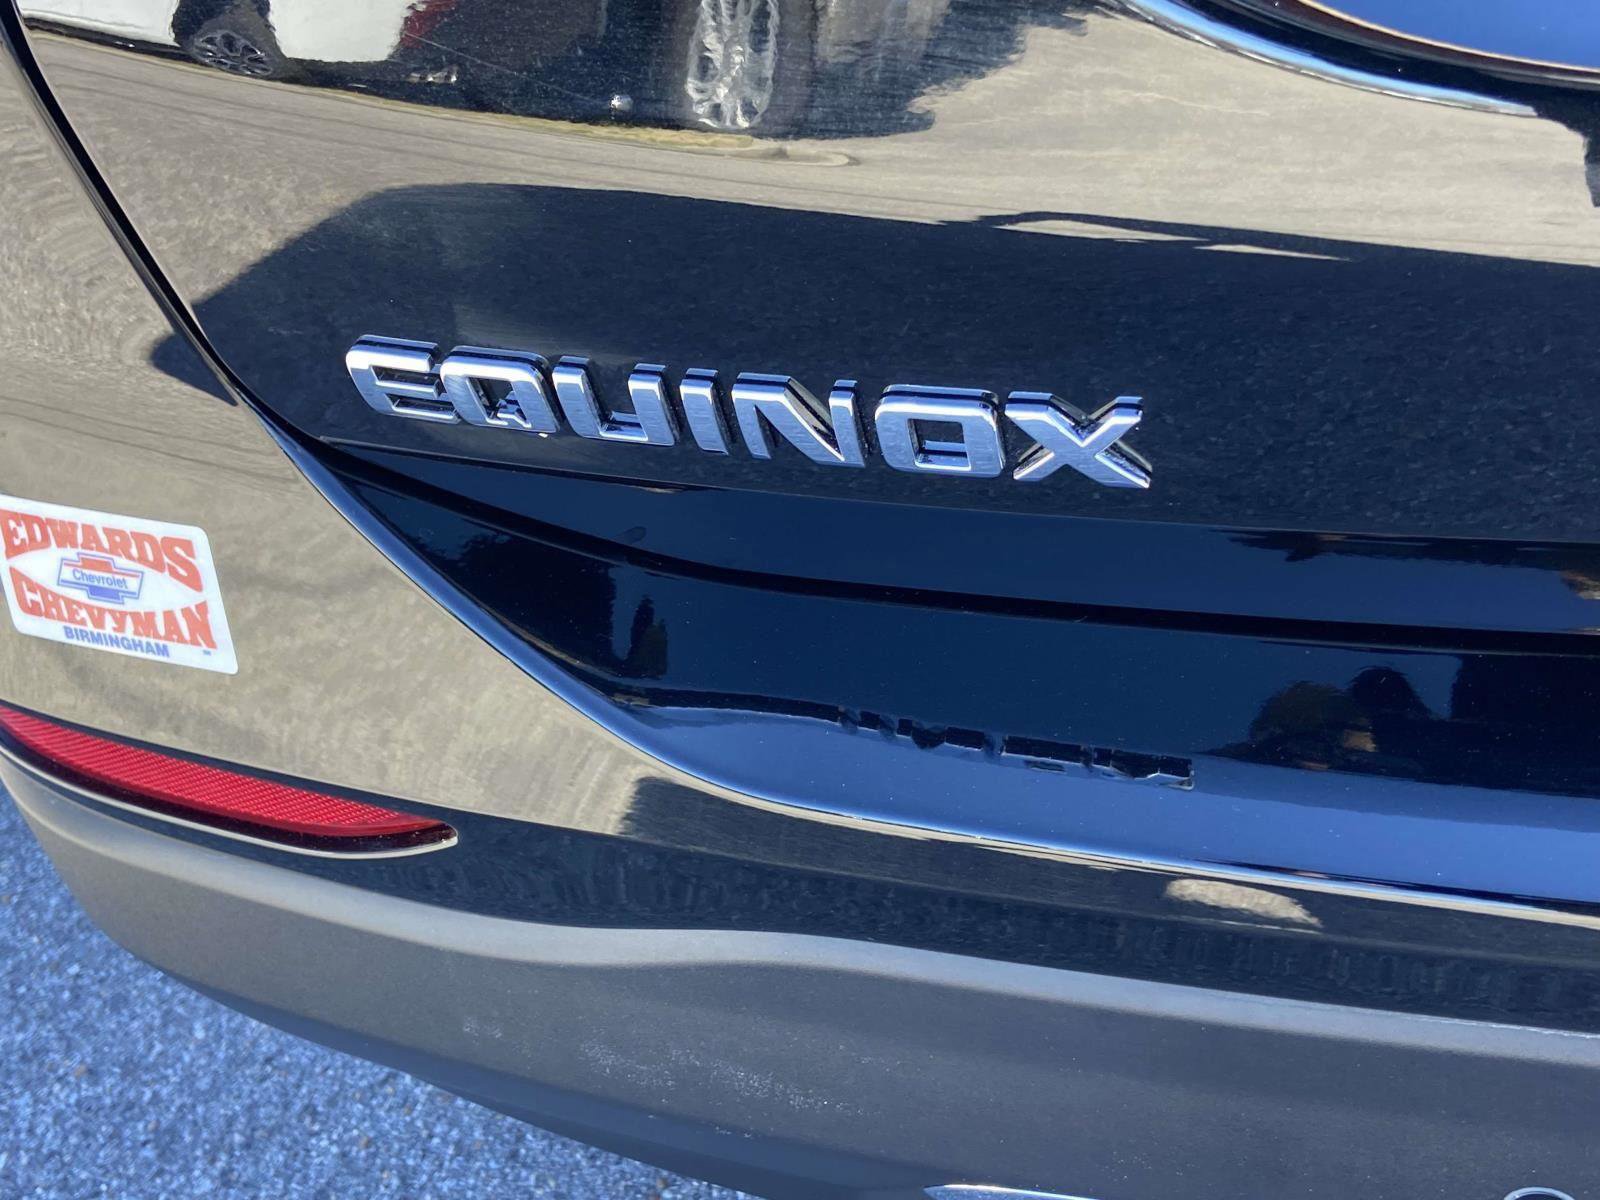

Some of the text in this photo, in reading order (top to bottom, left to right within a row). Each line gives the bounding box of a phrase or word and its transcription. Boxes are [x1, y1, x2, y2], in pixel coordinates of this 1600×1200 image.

[346, 335, 1153, 489] EQUINOX
[0, 509, 203, 592] EDWARDS
[72, 568, 129, 590] Chevrolet
[63, 626, 170, 658] BIRMINGHAM
